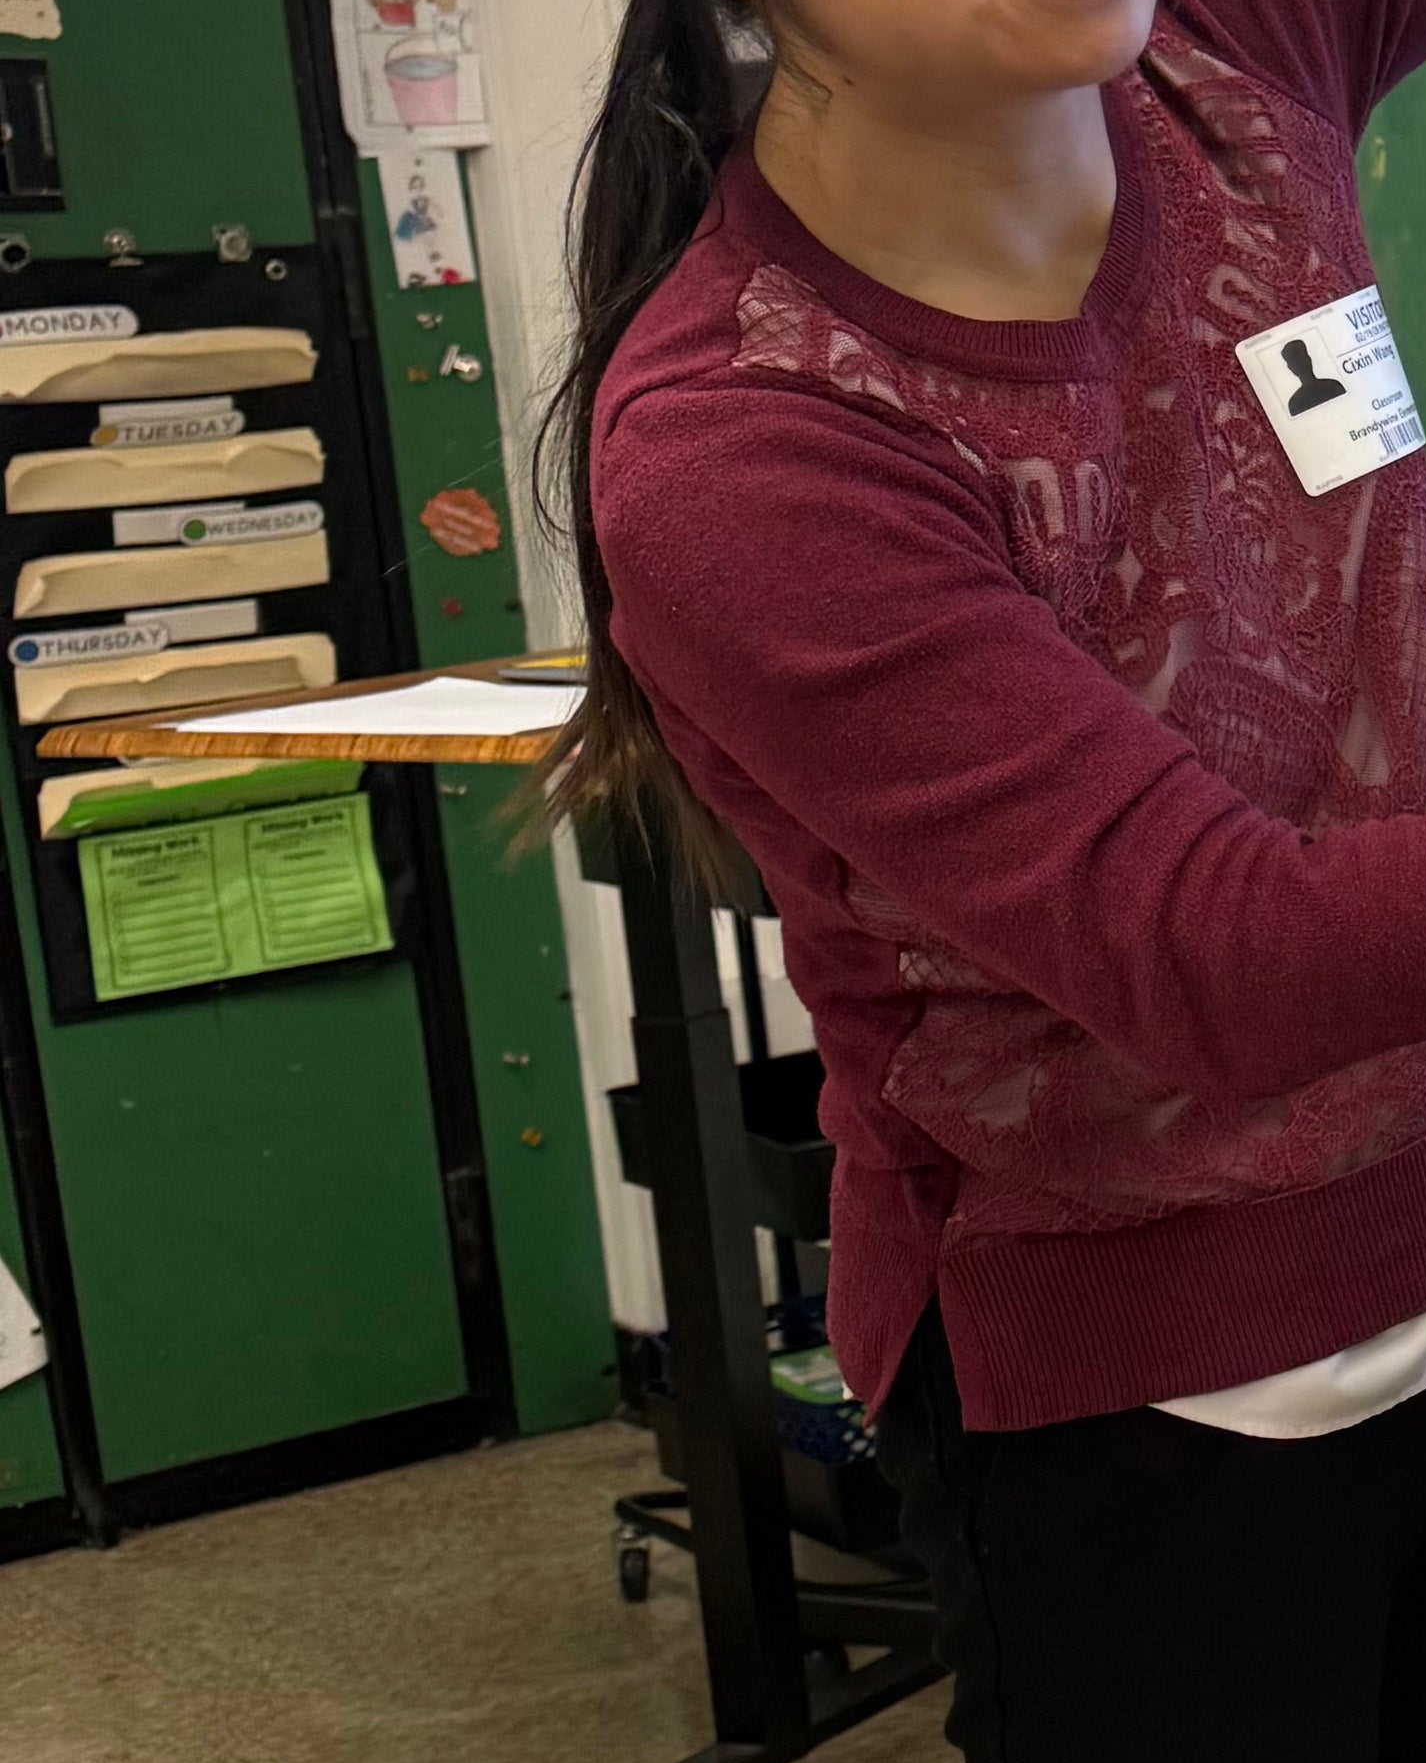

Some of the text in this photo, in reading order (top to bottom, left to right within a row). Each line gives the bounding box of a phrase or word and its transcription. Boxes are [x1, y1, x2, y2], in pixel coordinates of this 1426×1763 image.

[5, 311, 120, 335] MONDAY
[1345, 299, 1385, 331] VISITO
[1342, 352, 1373, 374] Cixin
[124, 416, 237, 443] TUESDAY
[206, 511, 318, 537] WEDNESDAY
[41, 628, 161, 655] THURSDAY
